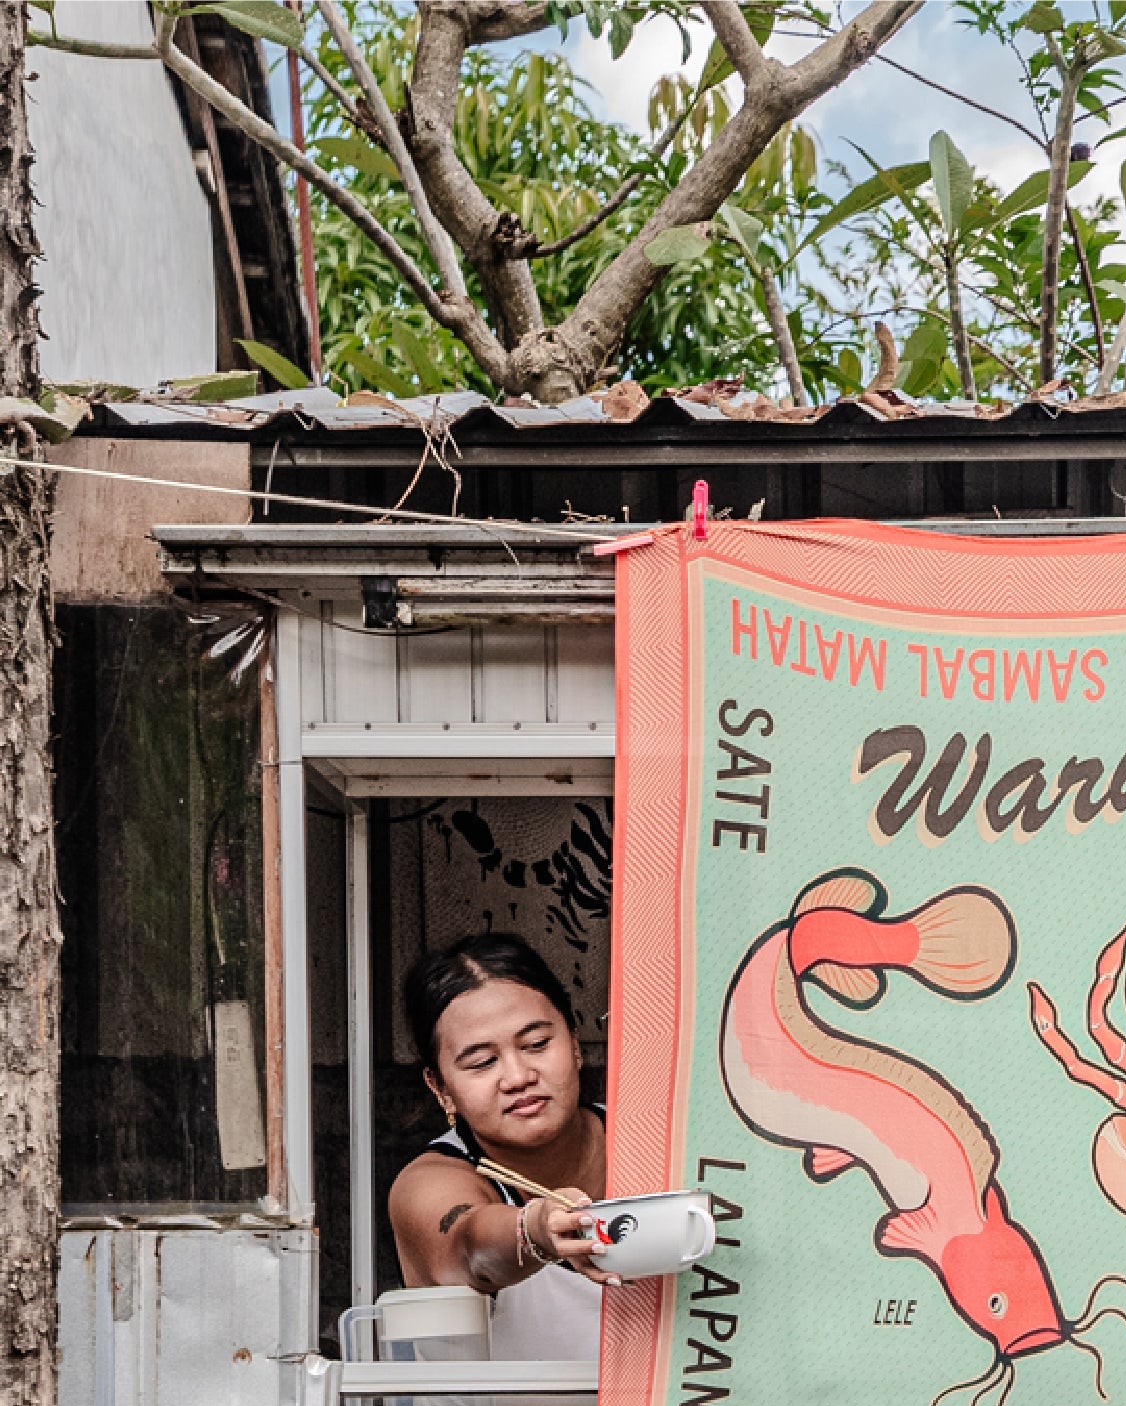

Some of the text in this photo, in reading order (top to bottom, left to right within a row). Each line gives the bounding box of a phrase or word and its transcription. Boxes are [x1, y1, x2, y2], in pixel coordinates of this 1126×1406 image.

[731, 598, 1108, 702] SAMBAL MATAH
[712, 699, 774, 854] SATE
[873, 1299, 918, 1326] LELE
